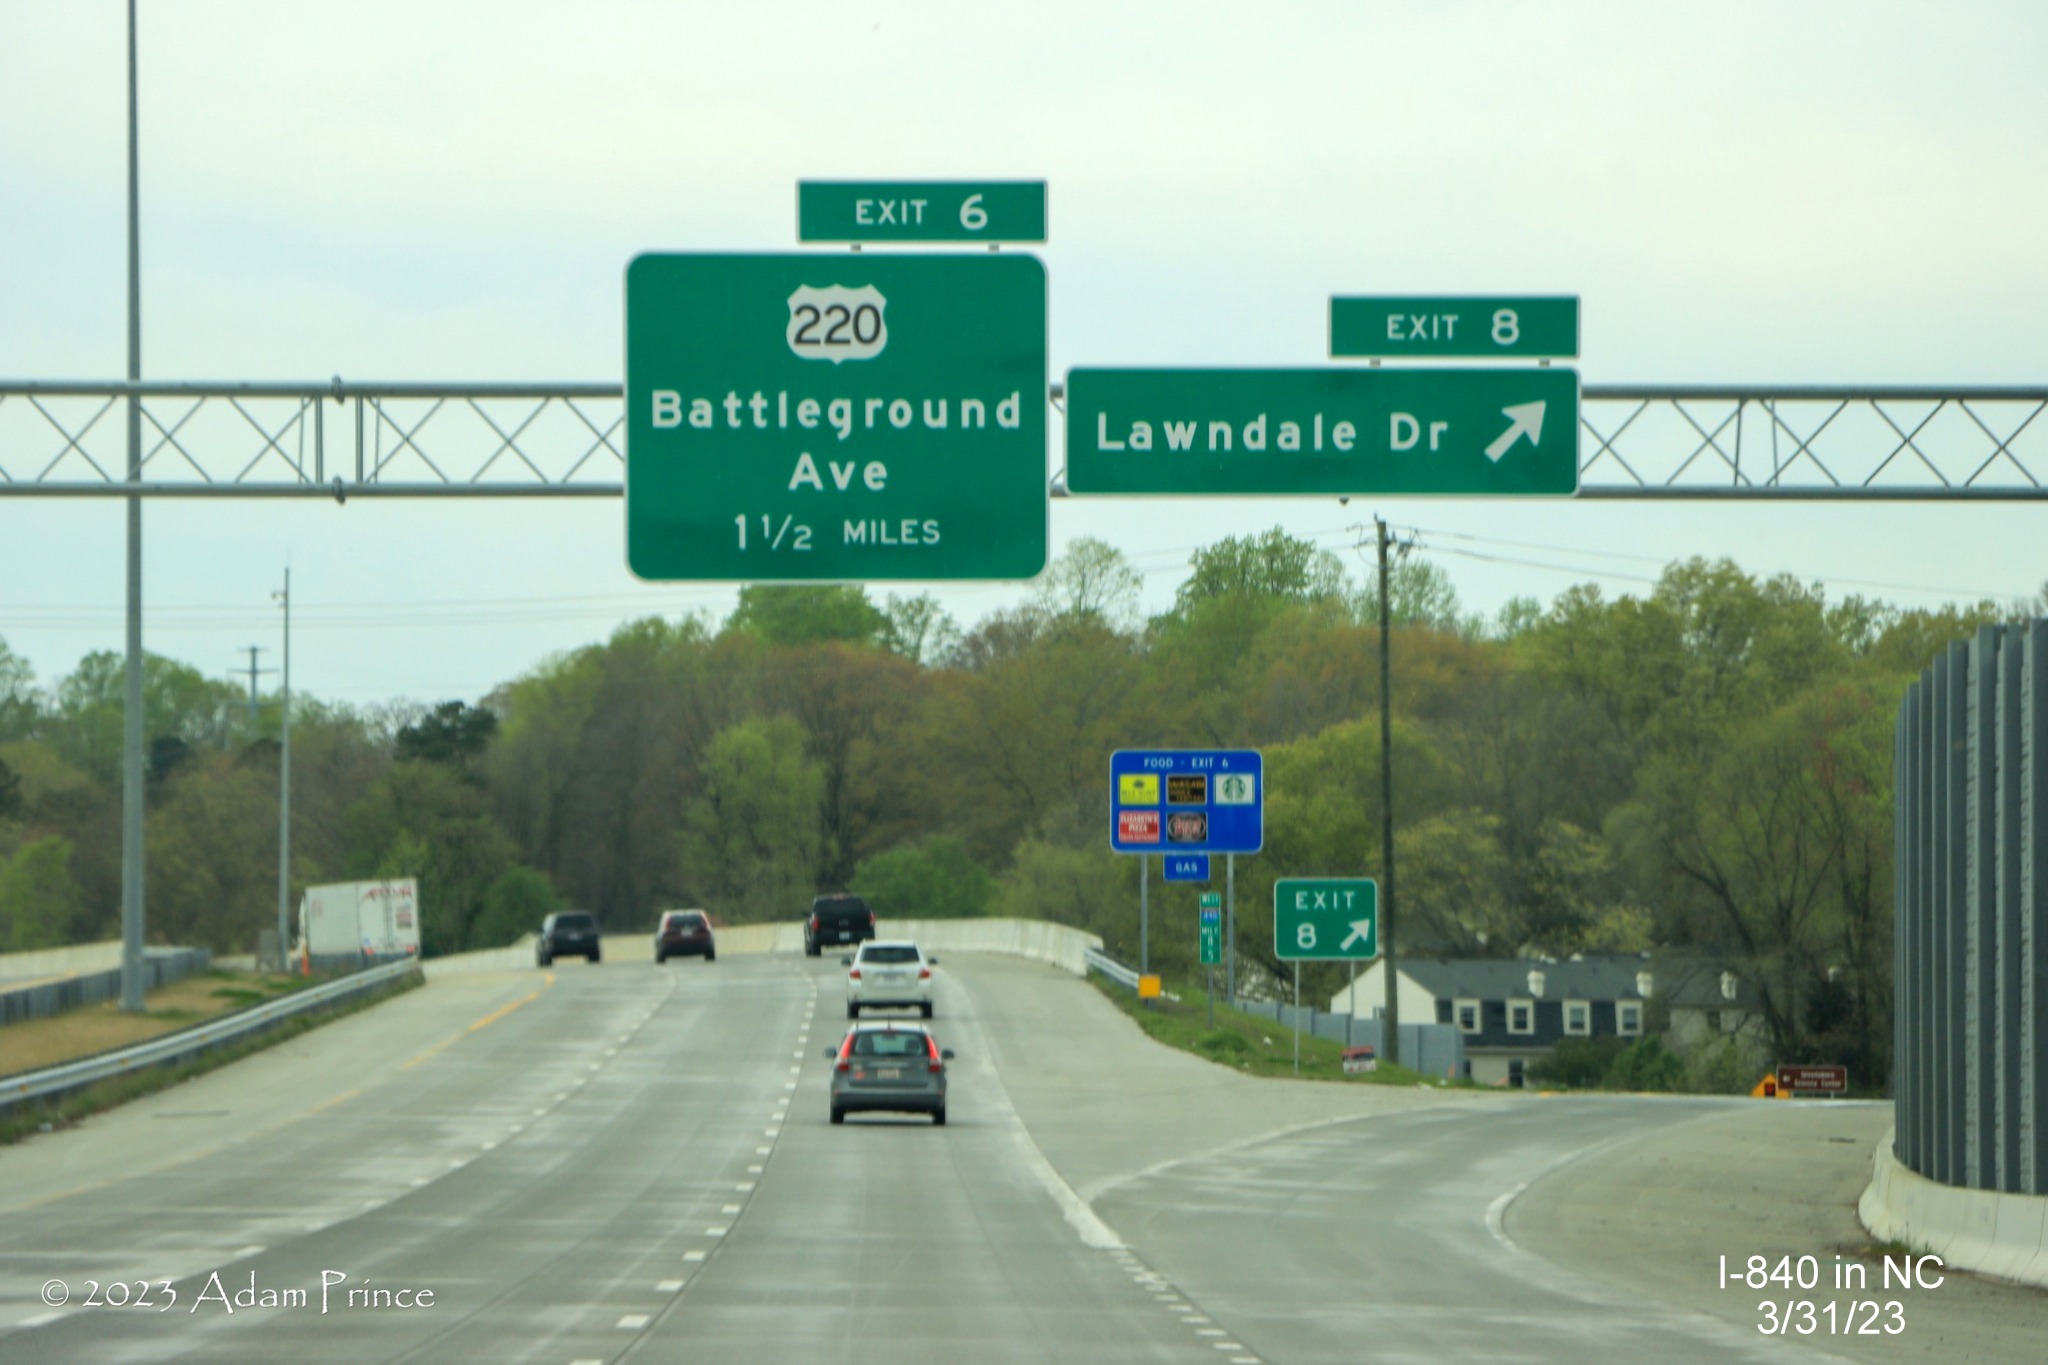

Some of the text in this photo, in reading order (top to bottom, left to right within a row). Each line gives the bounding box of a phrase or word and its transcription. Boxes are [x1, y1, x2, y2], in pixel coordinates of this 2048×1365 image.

[855, 194, 988, 230] EXIT 6
[793, 304, 882, 346] 220
[1386, 309, 1520, 345] EXIT 8
[652, 390, 1021, 440] Battleground
[1097, 412, 1449, 451] Lawndale Dr
[788, 452, 888, 491] Ave
[844, 519, 940, 544] MILES
[1144, 757, 1228, 769] FOOD EXIT 6
[1296, 891, 1355, 910] EXIT
[1297, 923, 1316, 949] 8
